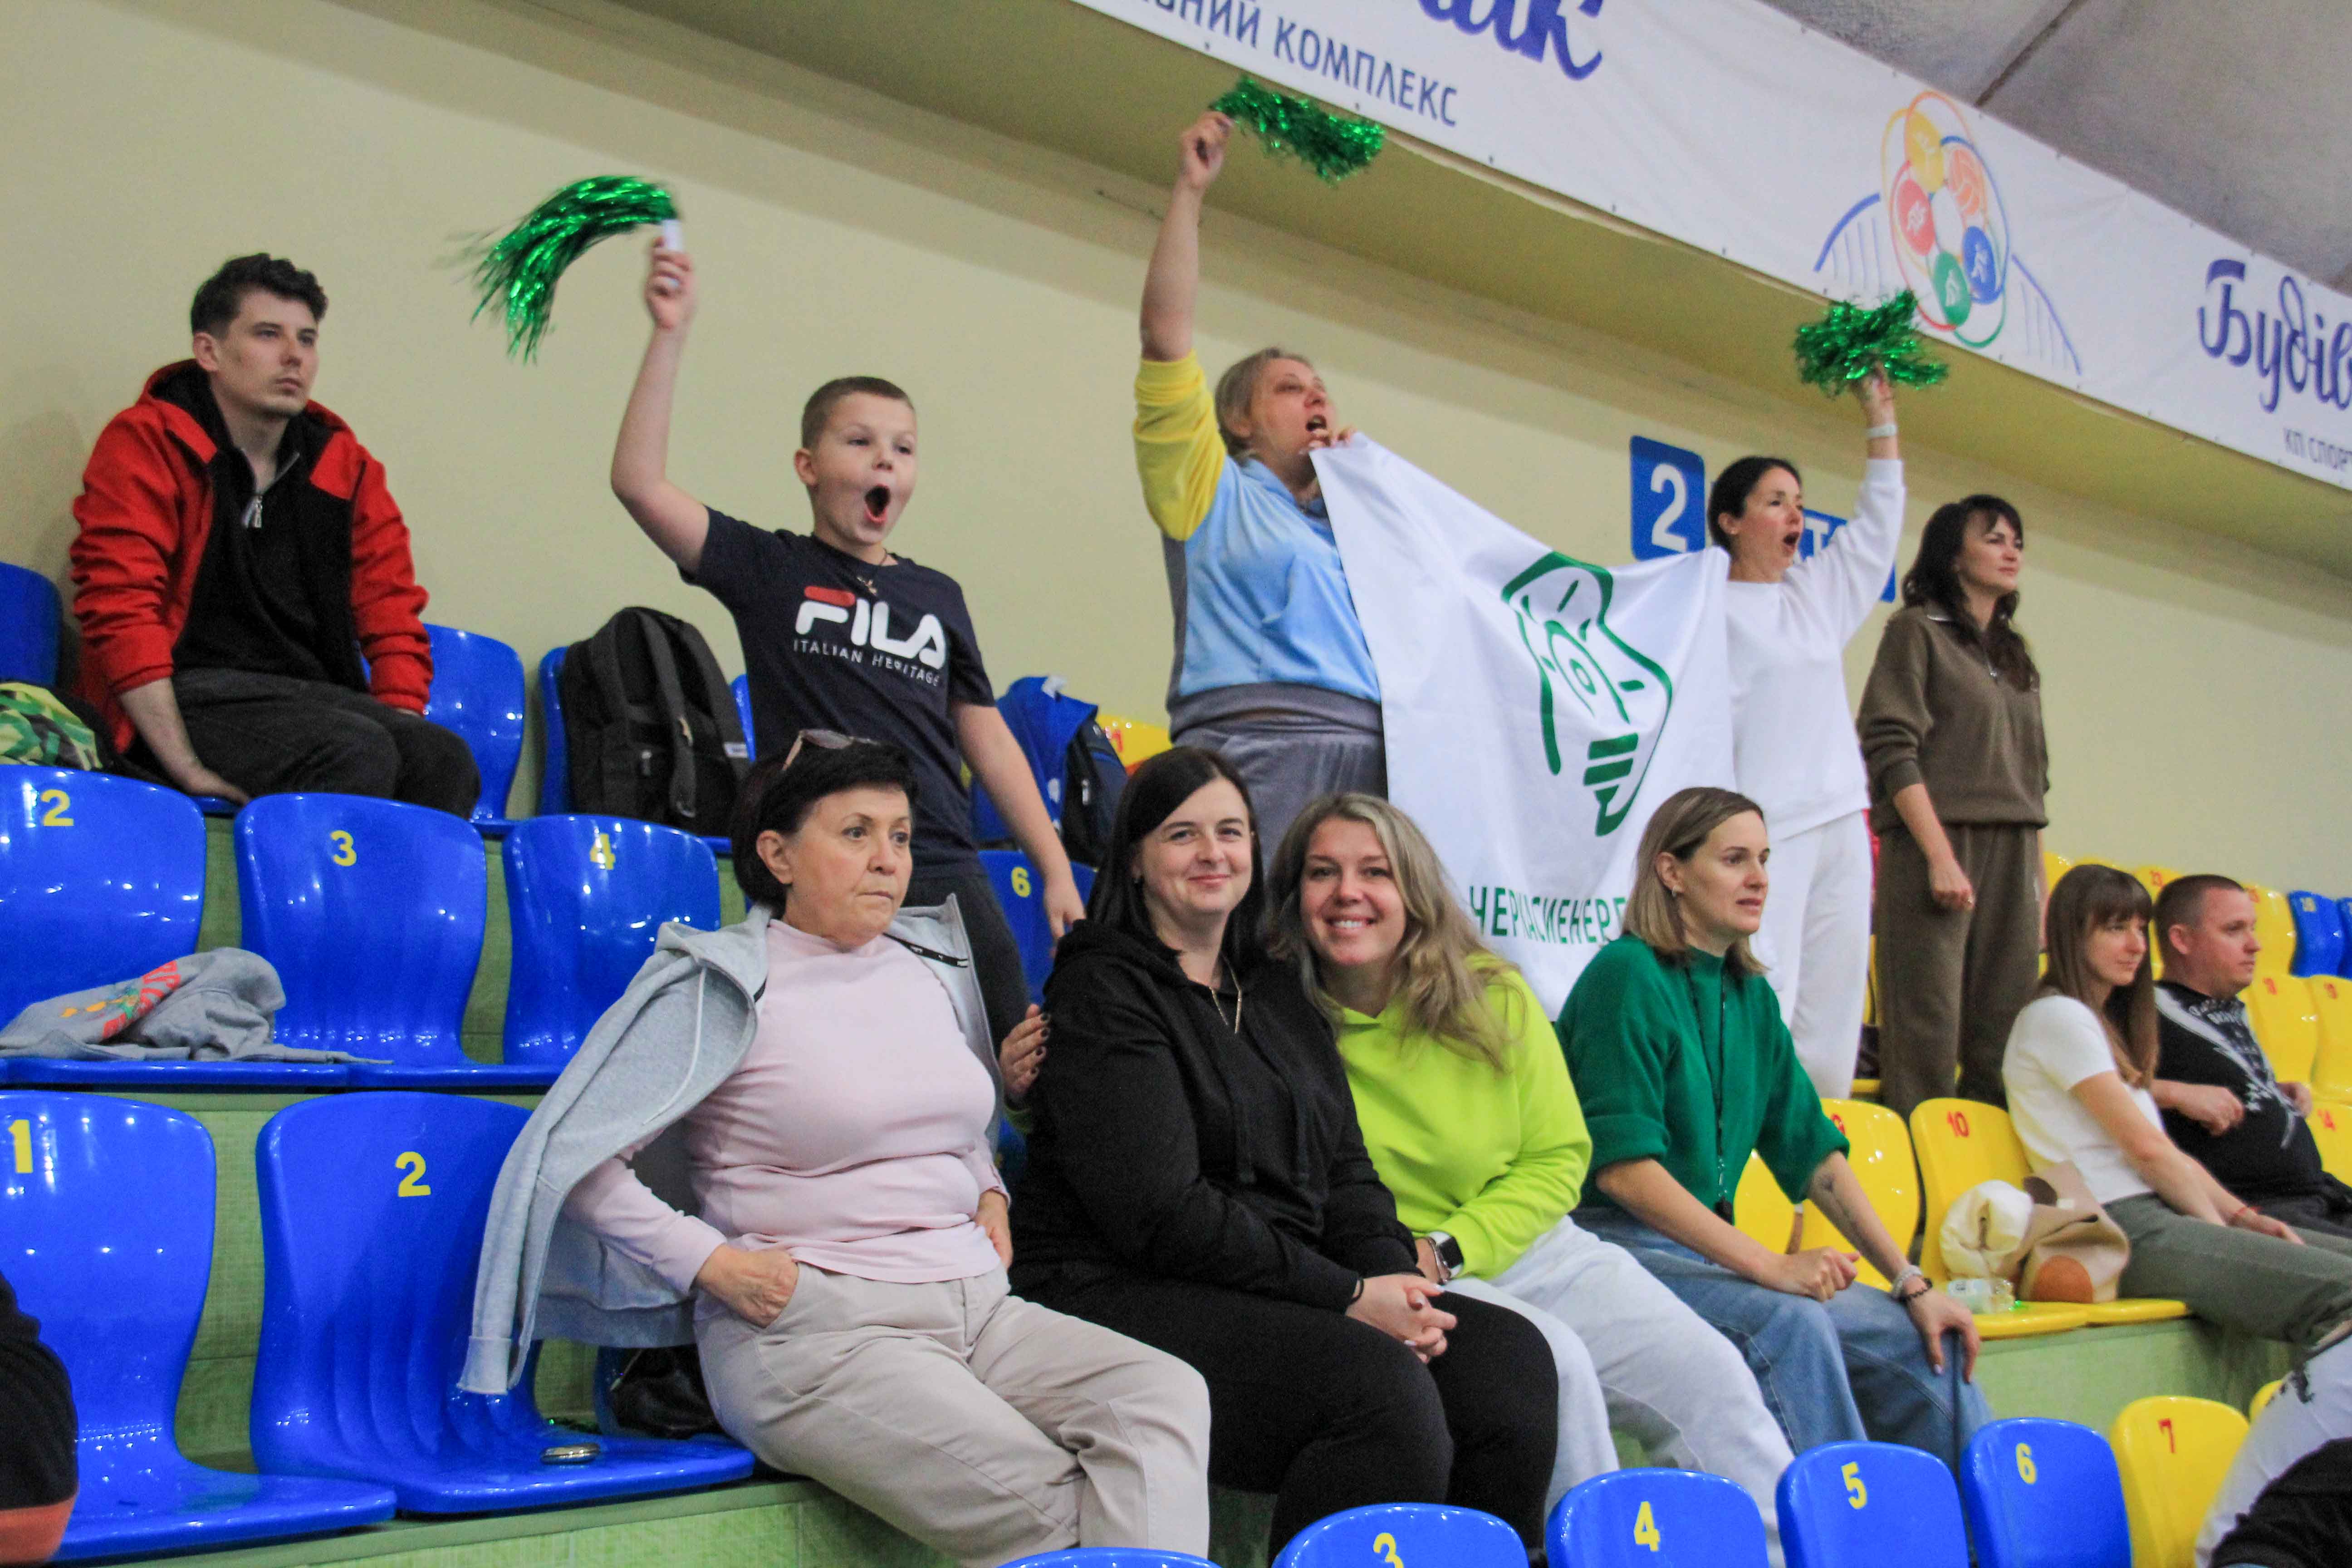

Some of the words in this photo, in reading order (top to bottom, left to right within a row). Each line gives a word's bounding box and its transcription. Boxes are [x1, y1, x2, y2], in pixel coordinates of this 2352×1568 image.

[1273, 16, 1458, 127] КОМПЛЕКС
[1651, 463, 1687, 552] 2
[795, 585, 946, 670] FILA
[793, 639, 862, 664] ITALIAN
[872, 653, 941, 687] HERITAGE
[41, 789, 74, 826] 2
[330, 830, 357, 866] 3
[590, 833, 615, 870] 4
[1011, 867, 1031, 897] 6
[8, 1119, 33, 1173] 1
[1946, 1110, 1970, 1138] 10
[395, 1152, 431, 1197] 2
[2158, 1418, 2176, 1454] 7
[1842, 1462, 1867, 1509] 5
[2016, 1443, 2037, 1485] 6
[1634, 1501, 1661, 1552] 4
